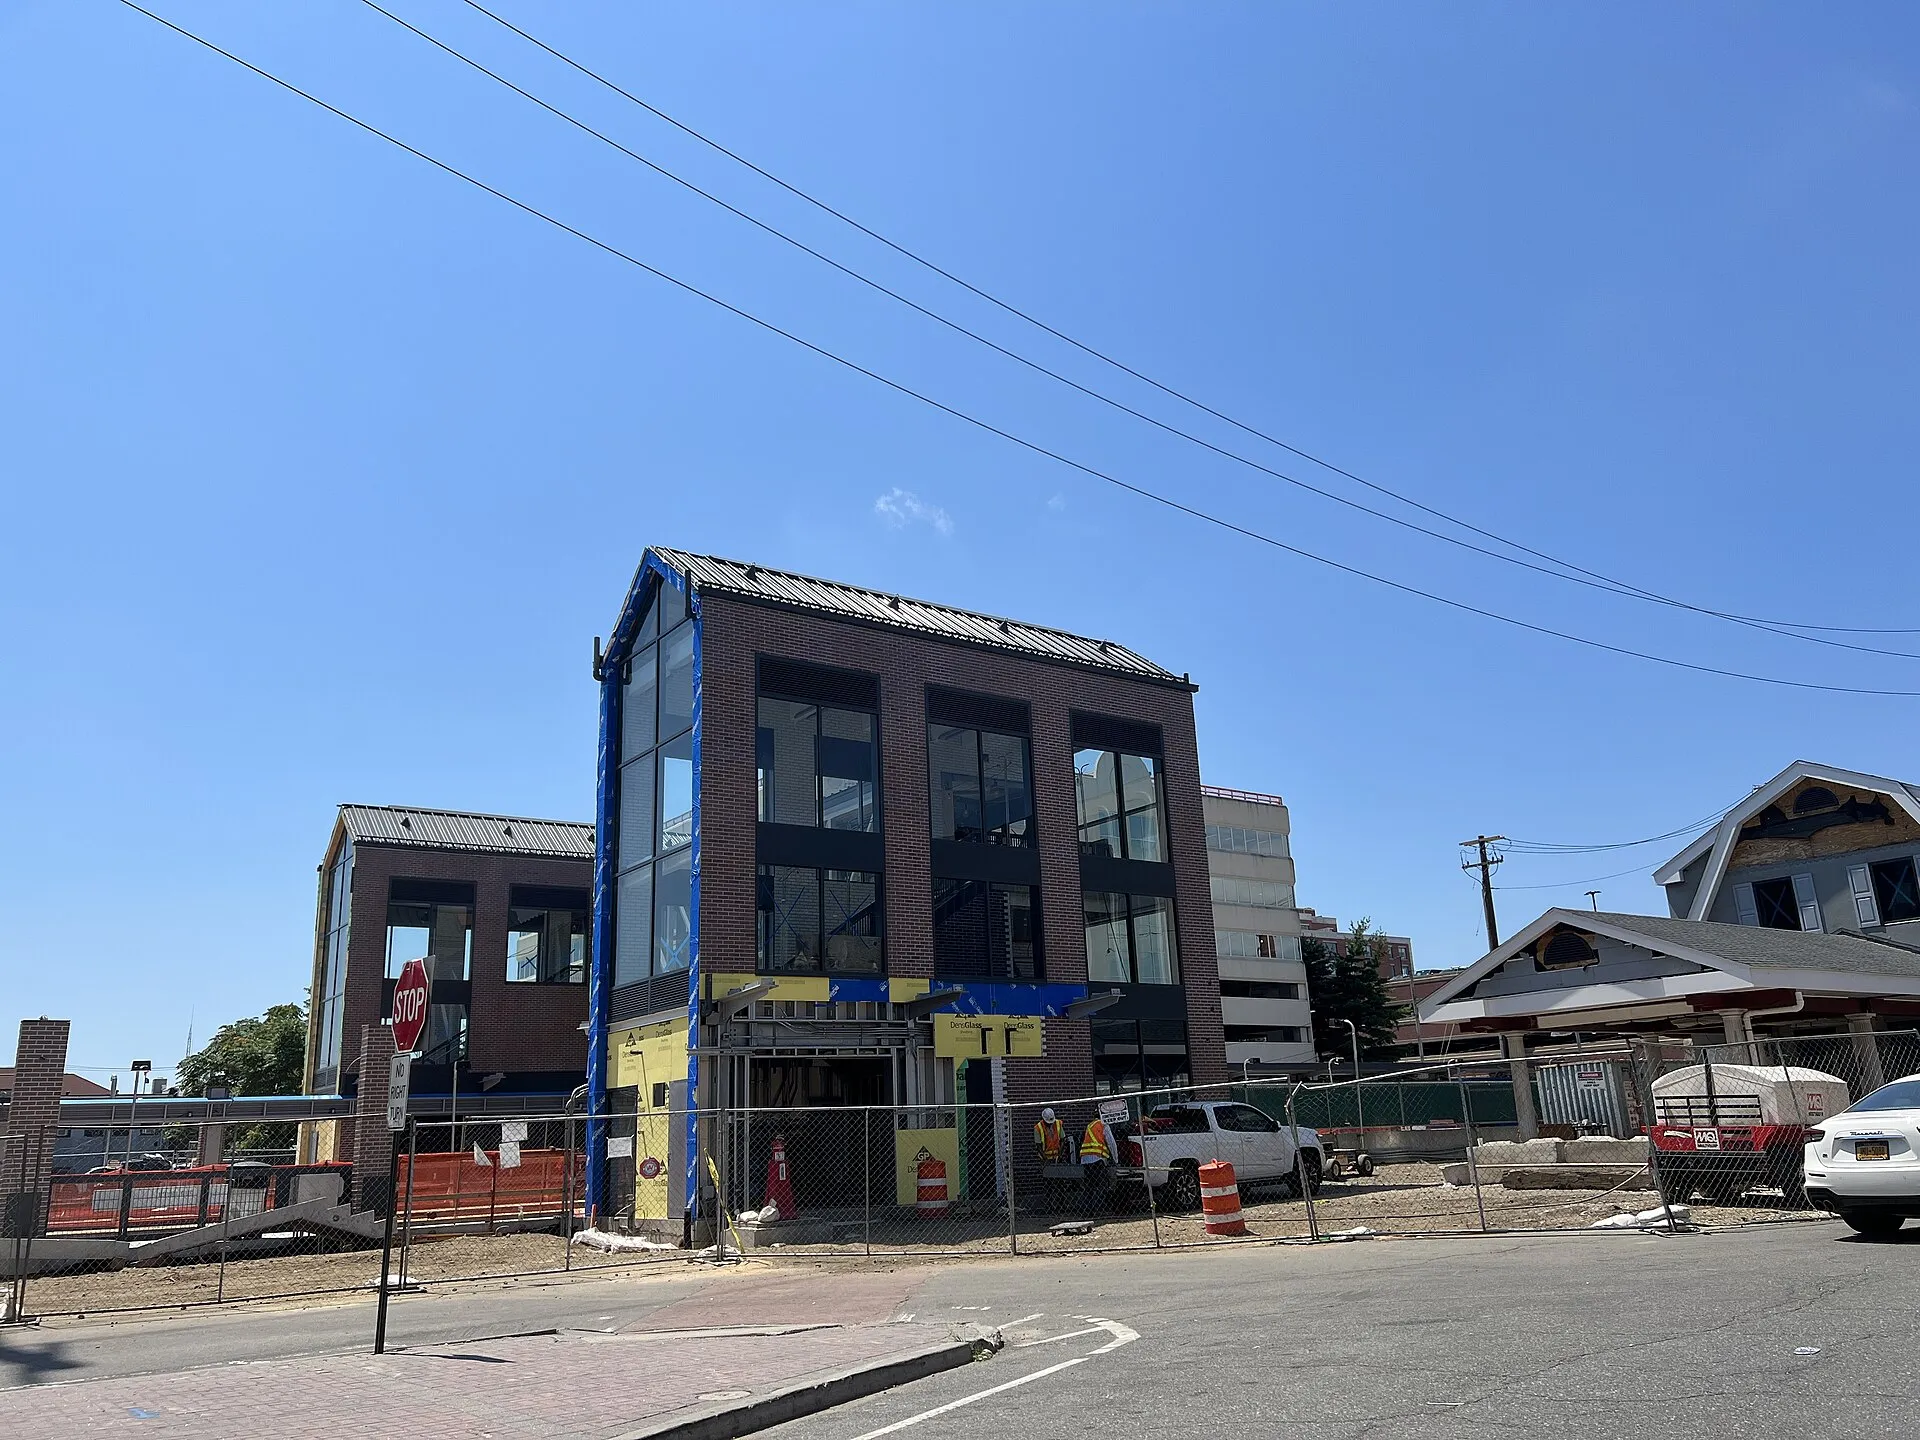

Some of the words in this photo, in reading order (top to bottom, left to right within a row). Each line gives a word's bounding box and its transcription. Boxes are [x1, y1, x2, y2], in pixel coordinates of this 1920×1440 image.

[394, 986, 425, 1024] STOP
[950, 1021, 982, 1029] DensGlass
[1003, 1022, 1035, 1030] DensGlass
[395, 1062, 405, 1079] NO
[391, 1084, 407, 1100] RIGHT
[389, 1106, 404, 1123] TURN
[1695, 1130, 1718, 1143] MQ
[917, 1152, 930, 1161] GP
